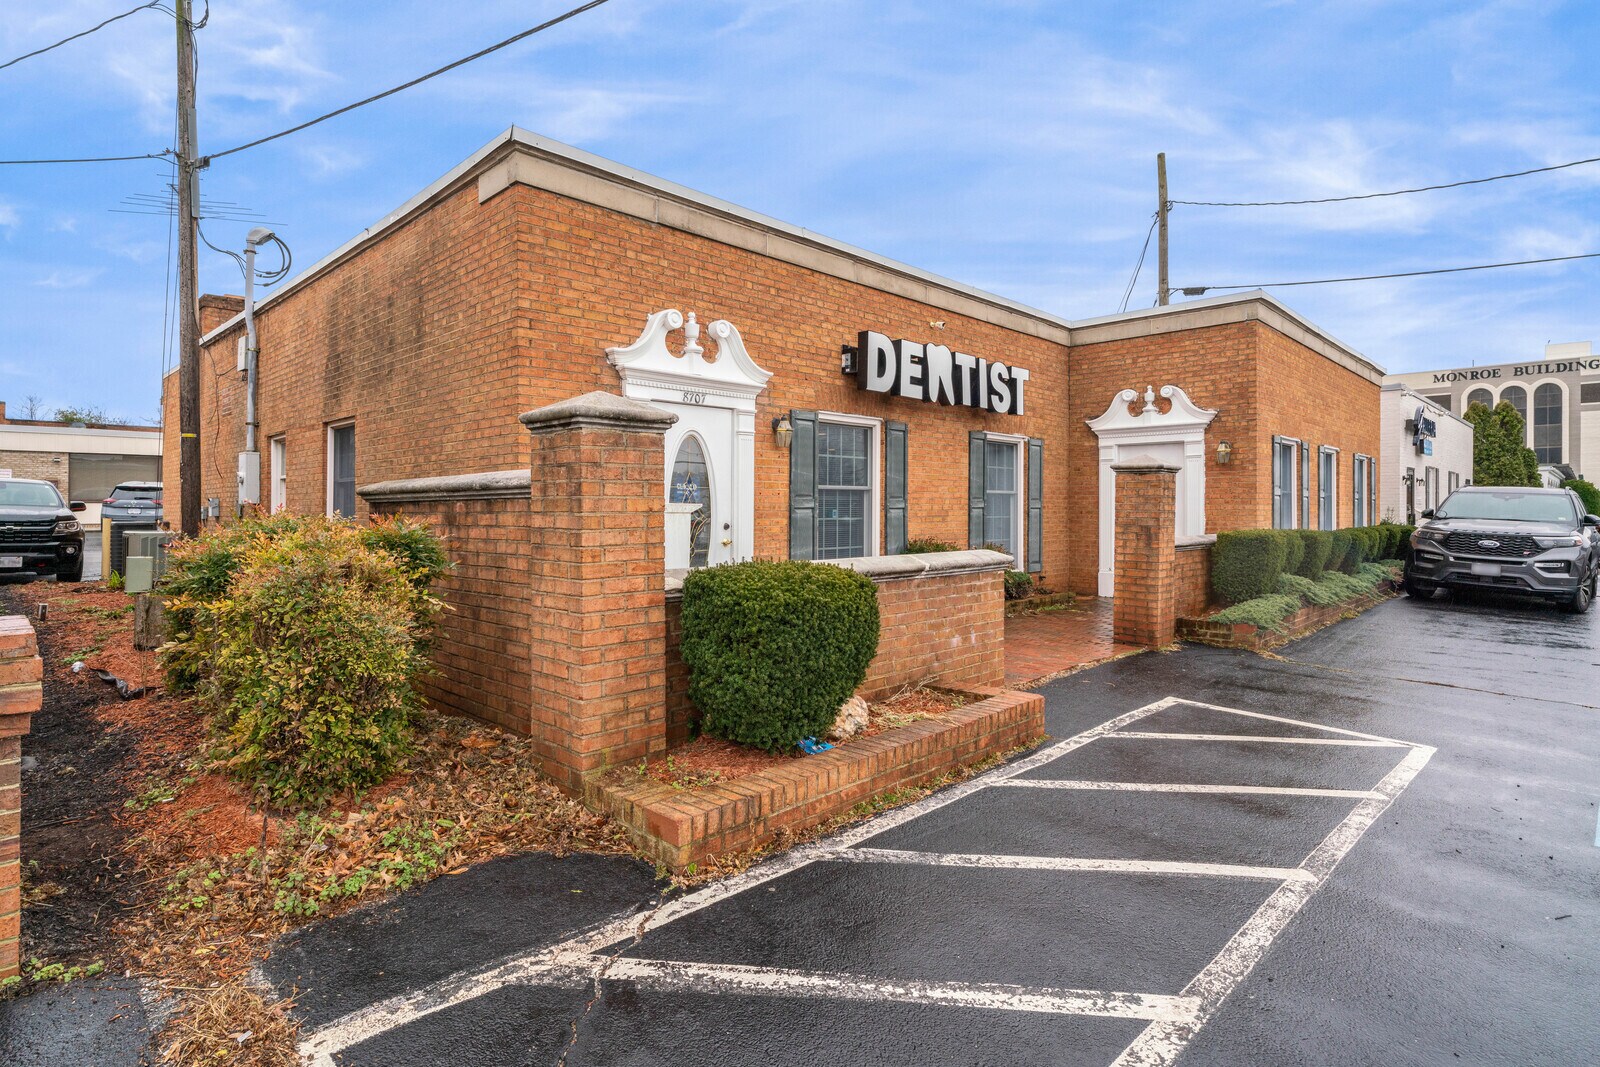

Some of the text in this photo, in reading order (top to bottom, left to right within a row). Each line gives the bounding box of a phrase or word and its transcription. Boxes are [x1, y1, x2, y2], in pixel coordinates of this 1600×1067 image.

[860, 330, 1030, 415] DENTIST
[1433, 359, 1600, 383] MONROE BUILDING
[683, 391, 706, 404] 8707
